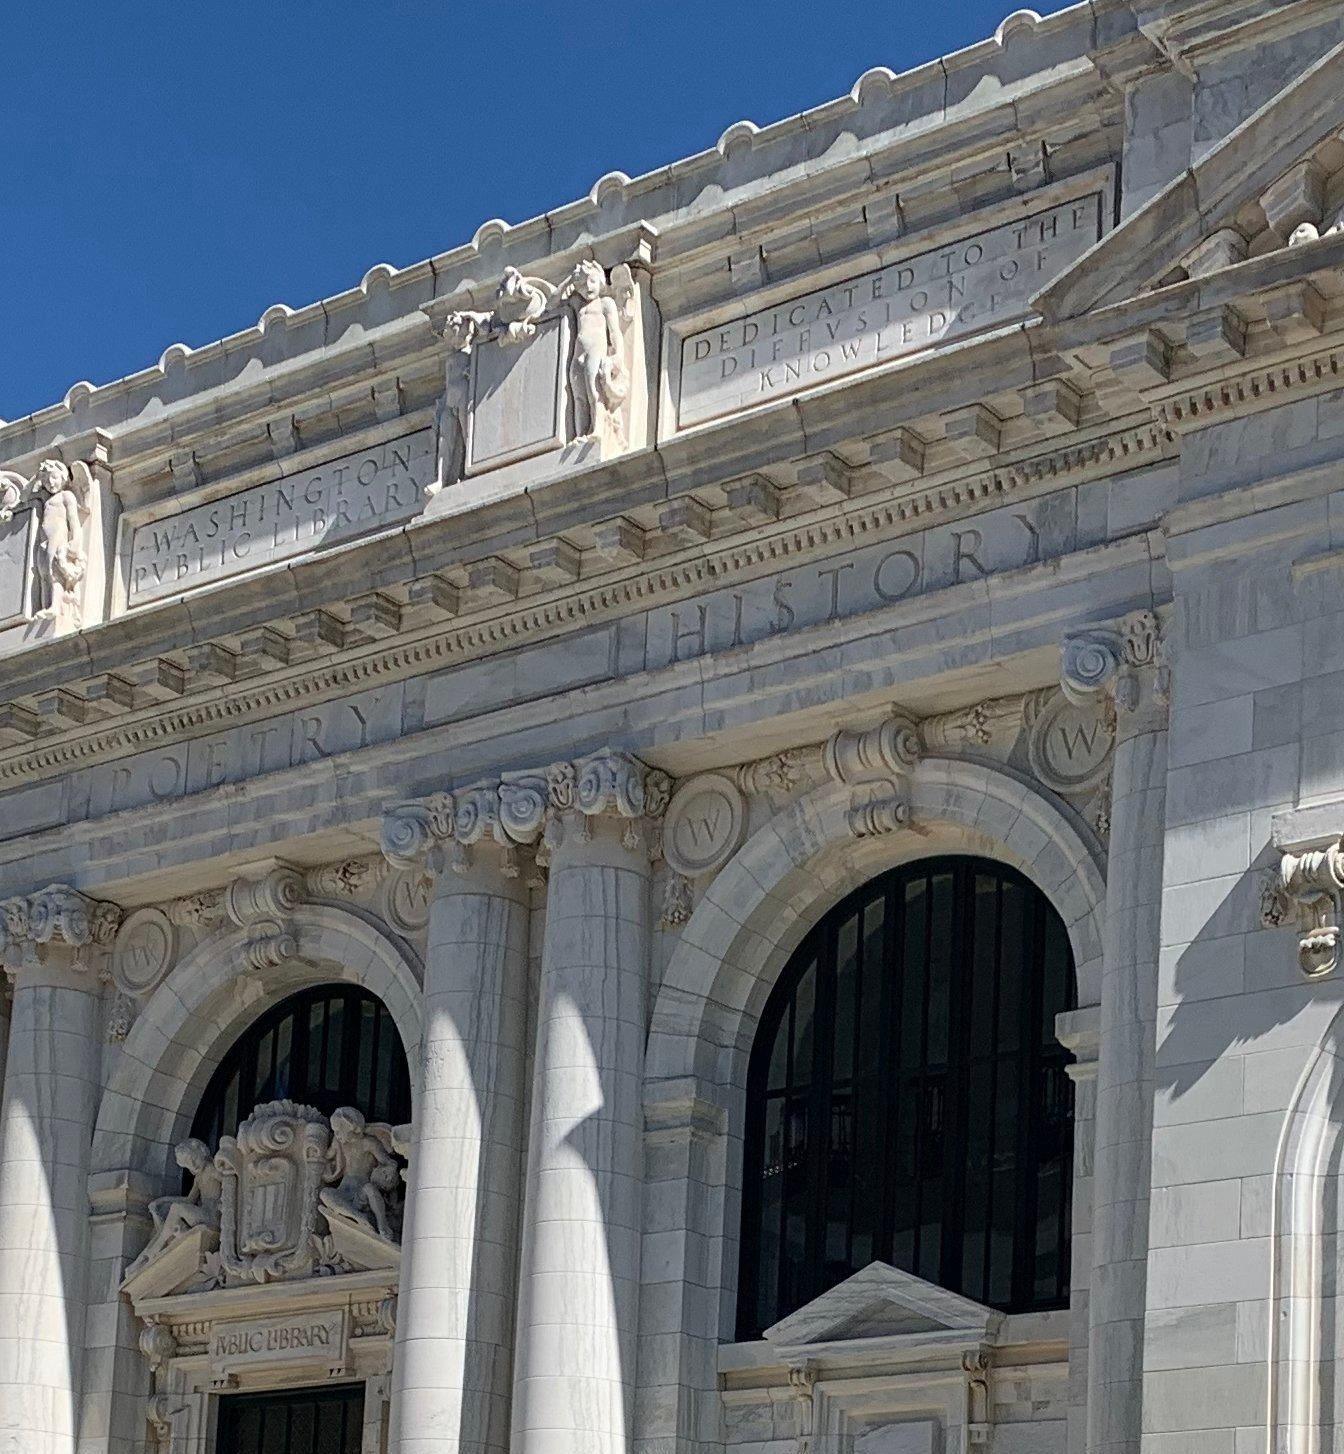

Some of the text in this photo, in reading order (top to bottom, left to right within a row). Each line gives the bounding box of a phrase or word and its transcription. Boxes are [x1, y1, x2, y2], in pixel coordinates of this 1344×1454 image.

[693, 206, 1085, 362] DEDICATED TO THE
[999, 250, 1047, 282] OF
[150, 444, 412, 555] WASHINGTON
[271, 474, 424, 549] LIBRARY
[670, 512, 1047, 661] HISTORY
[109, 697, 385, 812] POETRY
[267, 1320, 337, 1351] LIBRARY
